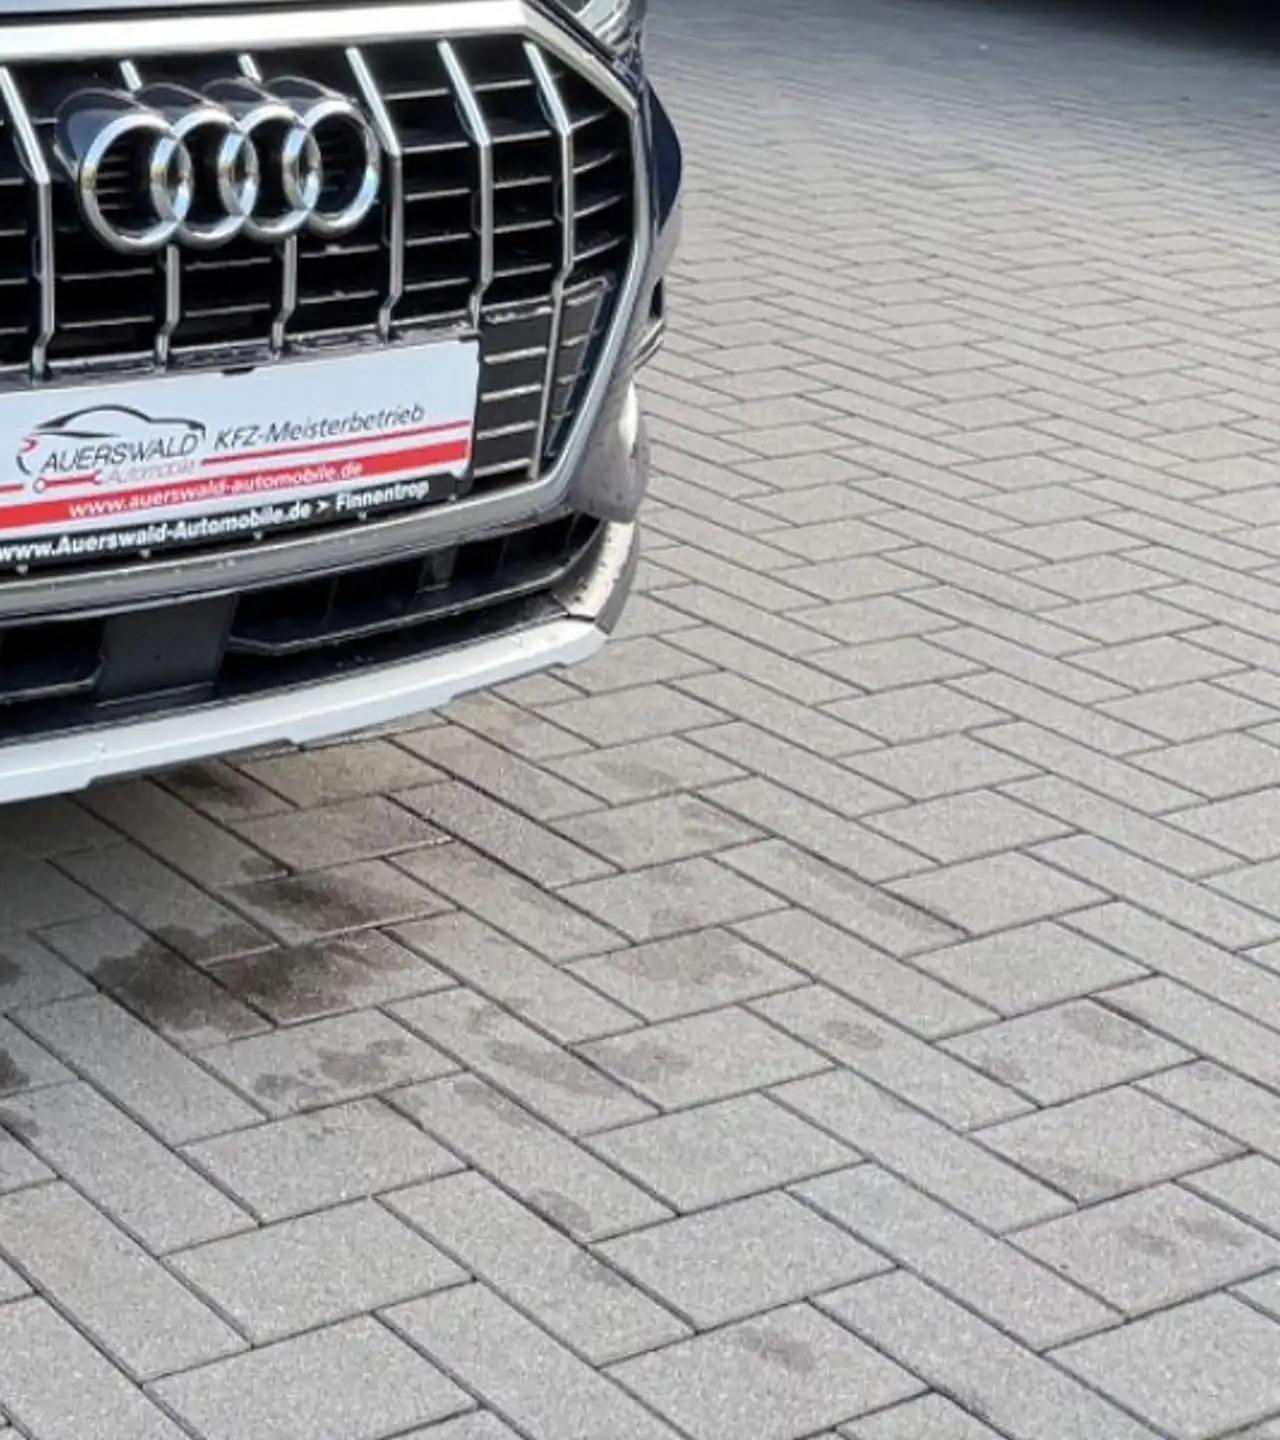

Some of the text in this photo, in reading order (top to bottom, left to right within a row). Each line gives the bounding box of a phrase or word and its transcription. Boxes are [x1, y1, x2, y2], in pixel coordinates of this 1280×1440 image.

[213, 403, 425, 451] KFZ-Meisterbetrieb
[40, 433, 199, 474] AUERSWALD
[68, 461, 364, 518] www.auerswald-automobile.de
[335, 477, 430, 512] Finnentrop
